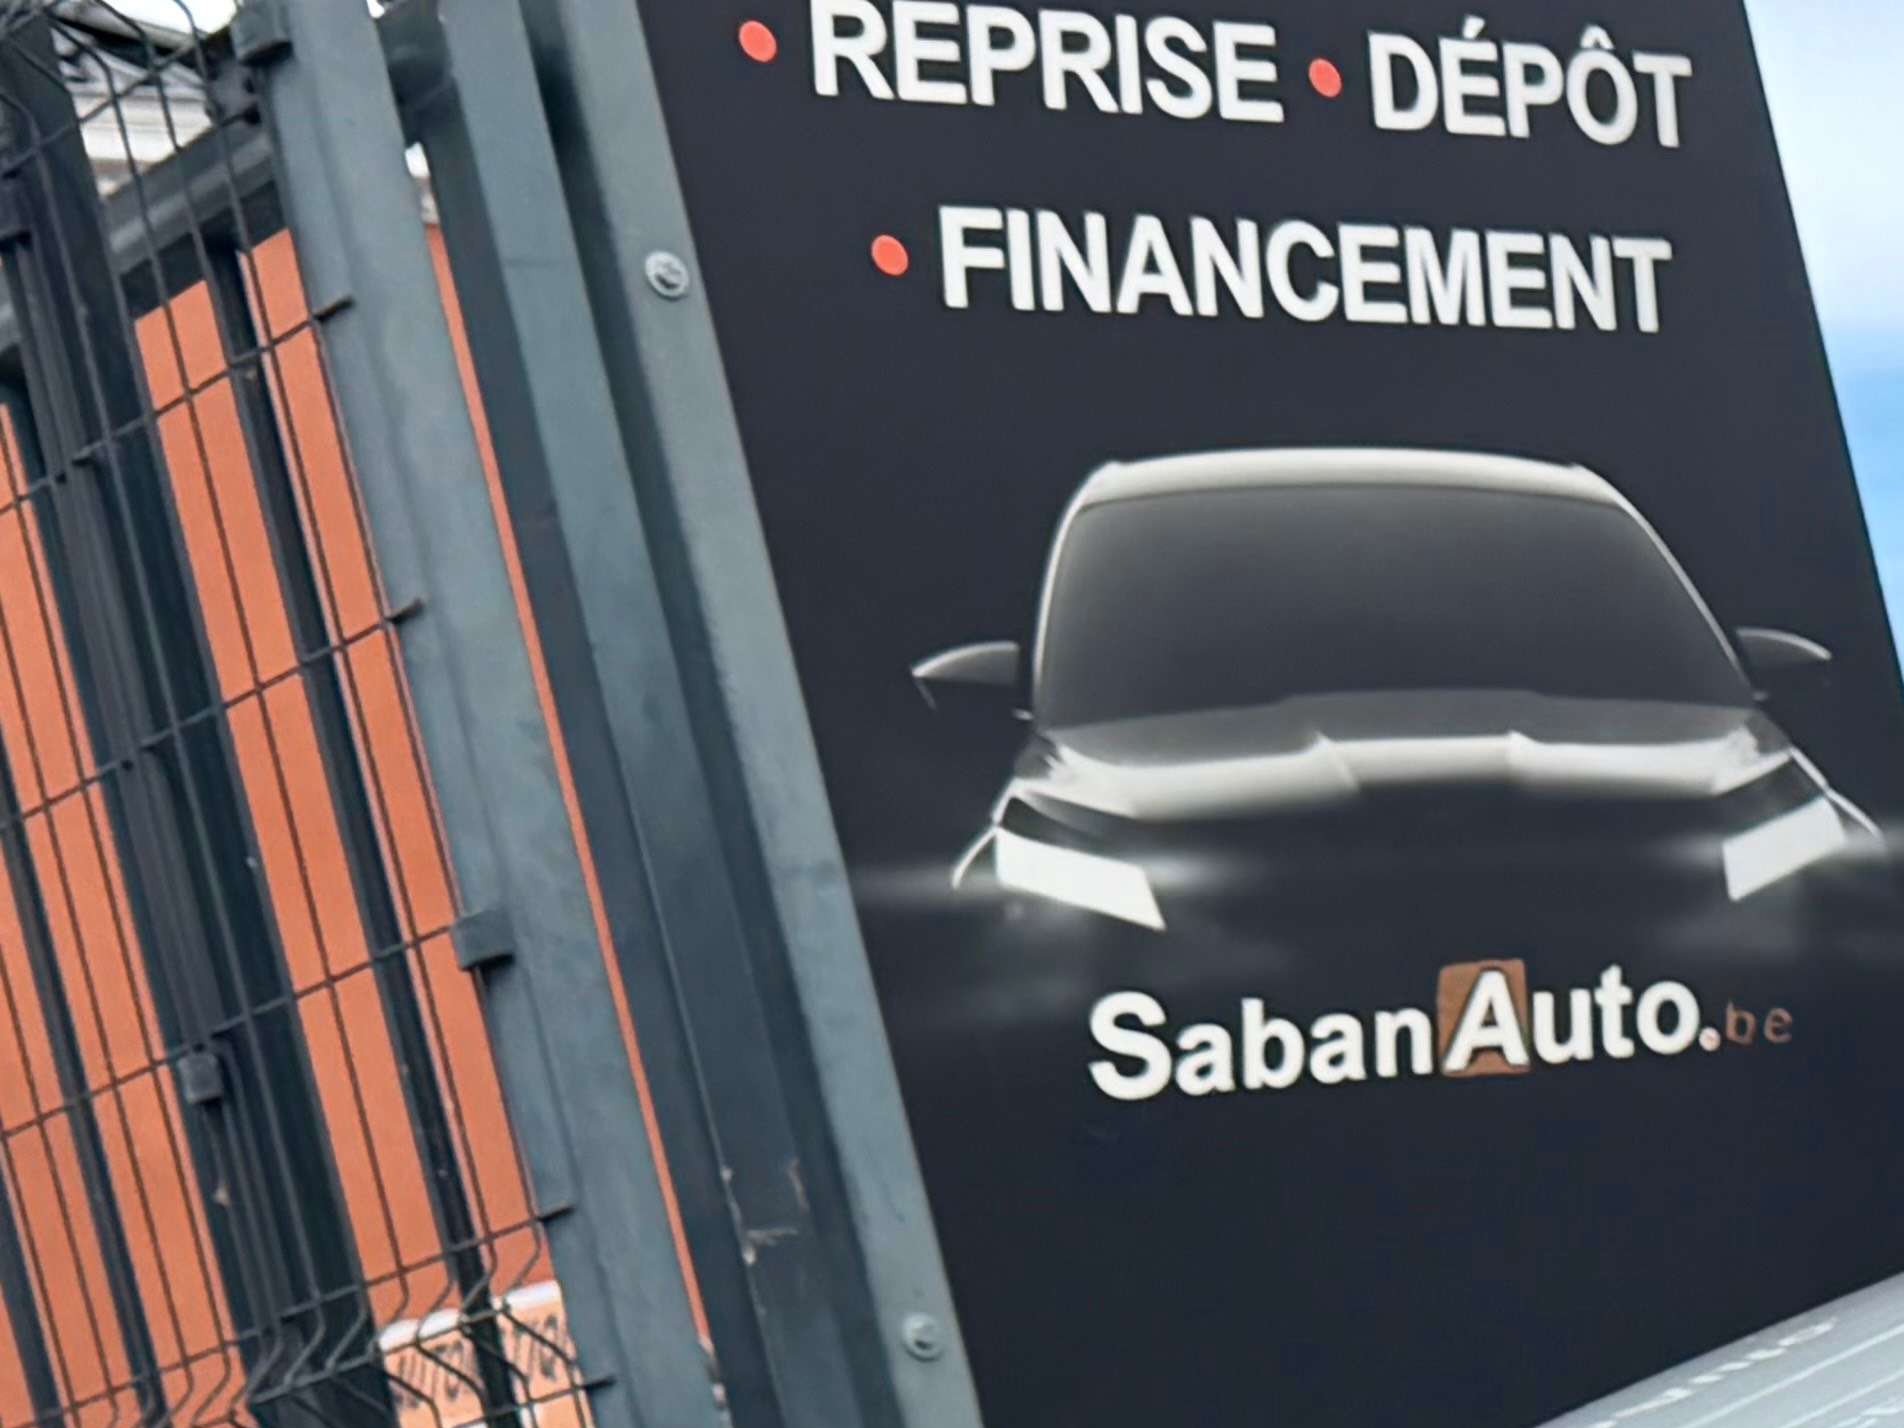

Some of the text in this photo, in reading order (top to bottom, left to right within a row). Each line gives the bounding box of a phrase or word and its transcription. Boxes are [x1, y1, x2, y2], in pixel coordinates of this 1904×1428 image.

[811, 0, 1694, 149] REPRISE DÉPÔT
[937, 204, 1674, 334] FINANCEMENT
